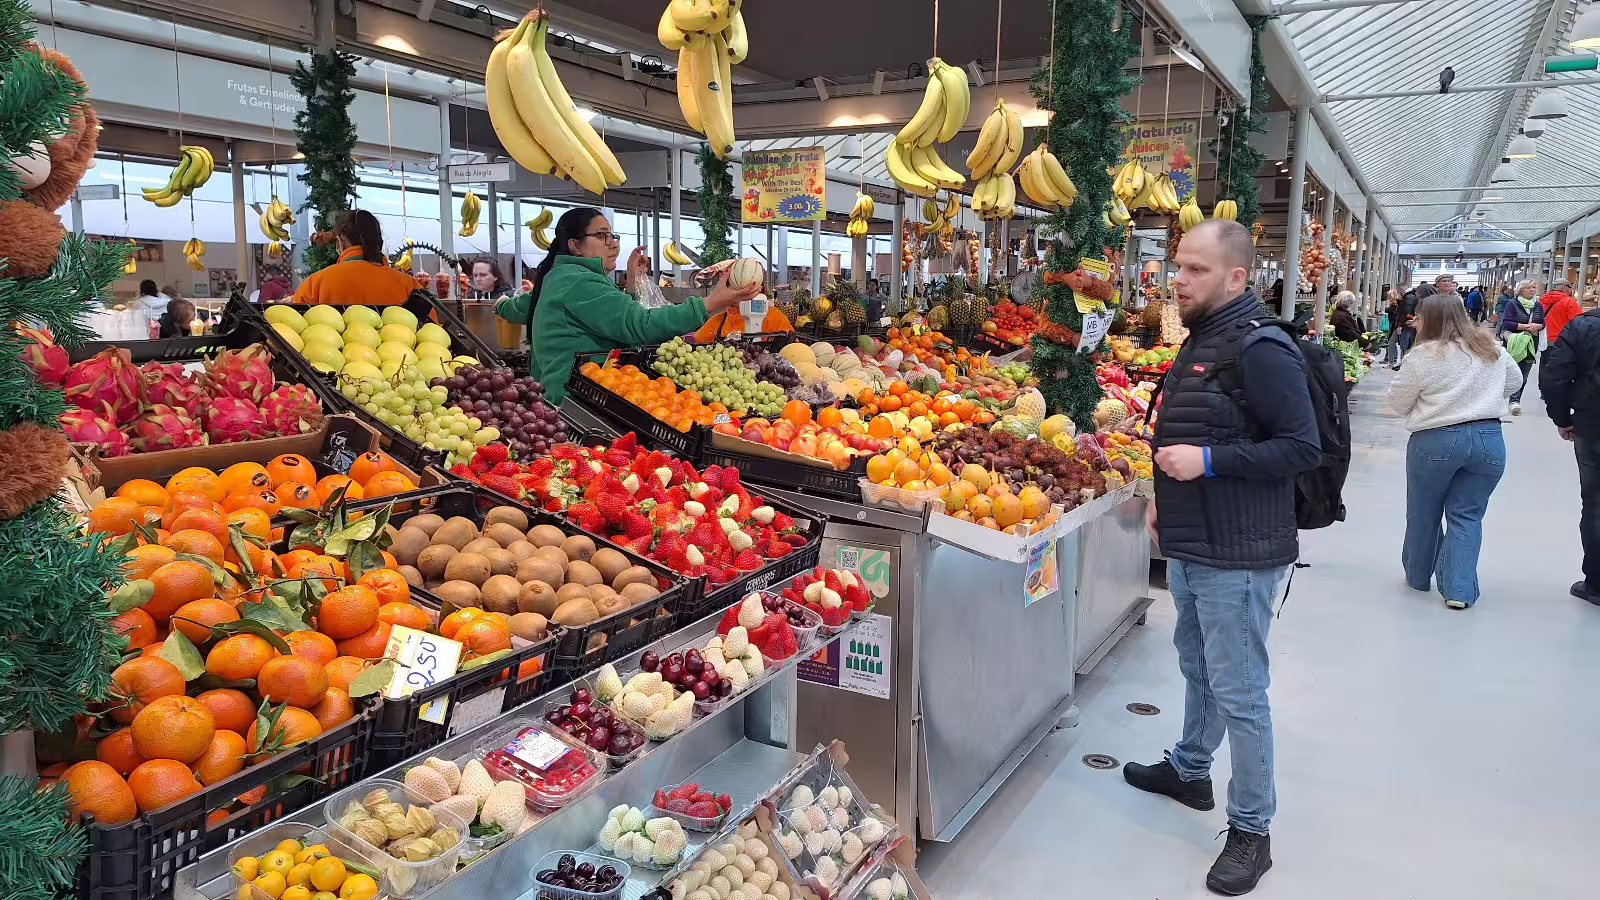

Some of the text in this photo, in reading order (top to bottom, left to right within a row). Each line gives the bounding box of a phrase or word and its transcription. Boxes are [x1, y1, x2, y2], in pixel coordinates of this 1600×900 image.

[227, 79, 258, 94] Frutas
[239, 95, 296, 114] & Gertrudes
[1129, 123, 1193, 139] Naturais
[794, 152, 820, 162] Fruta
[1086, 320, 1098, 331] MB
